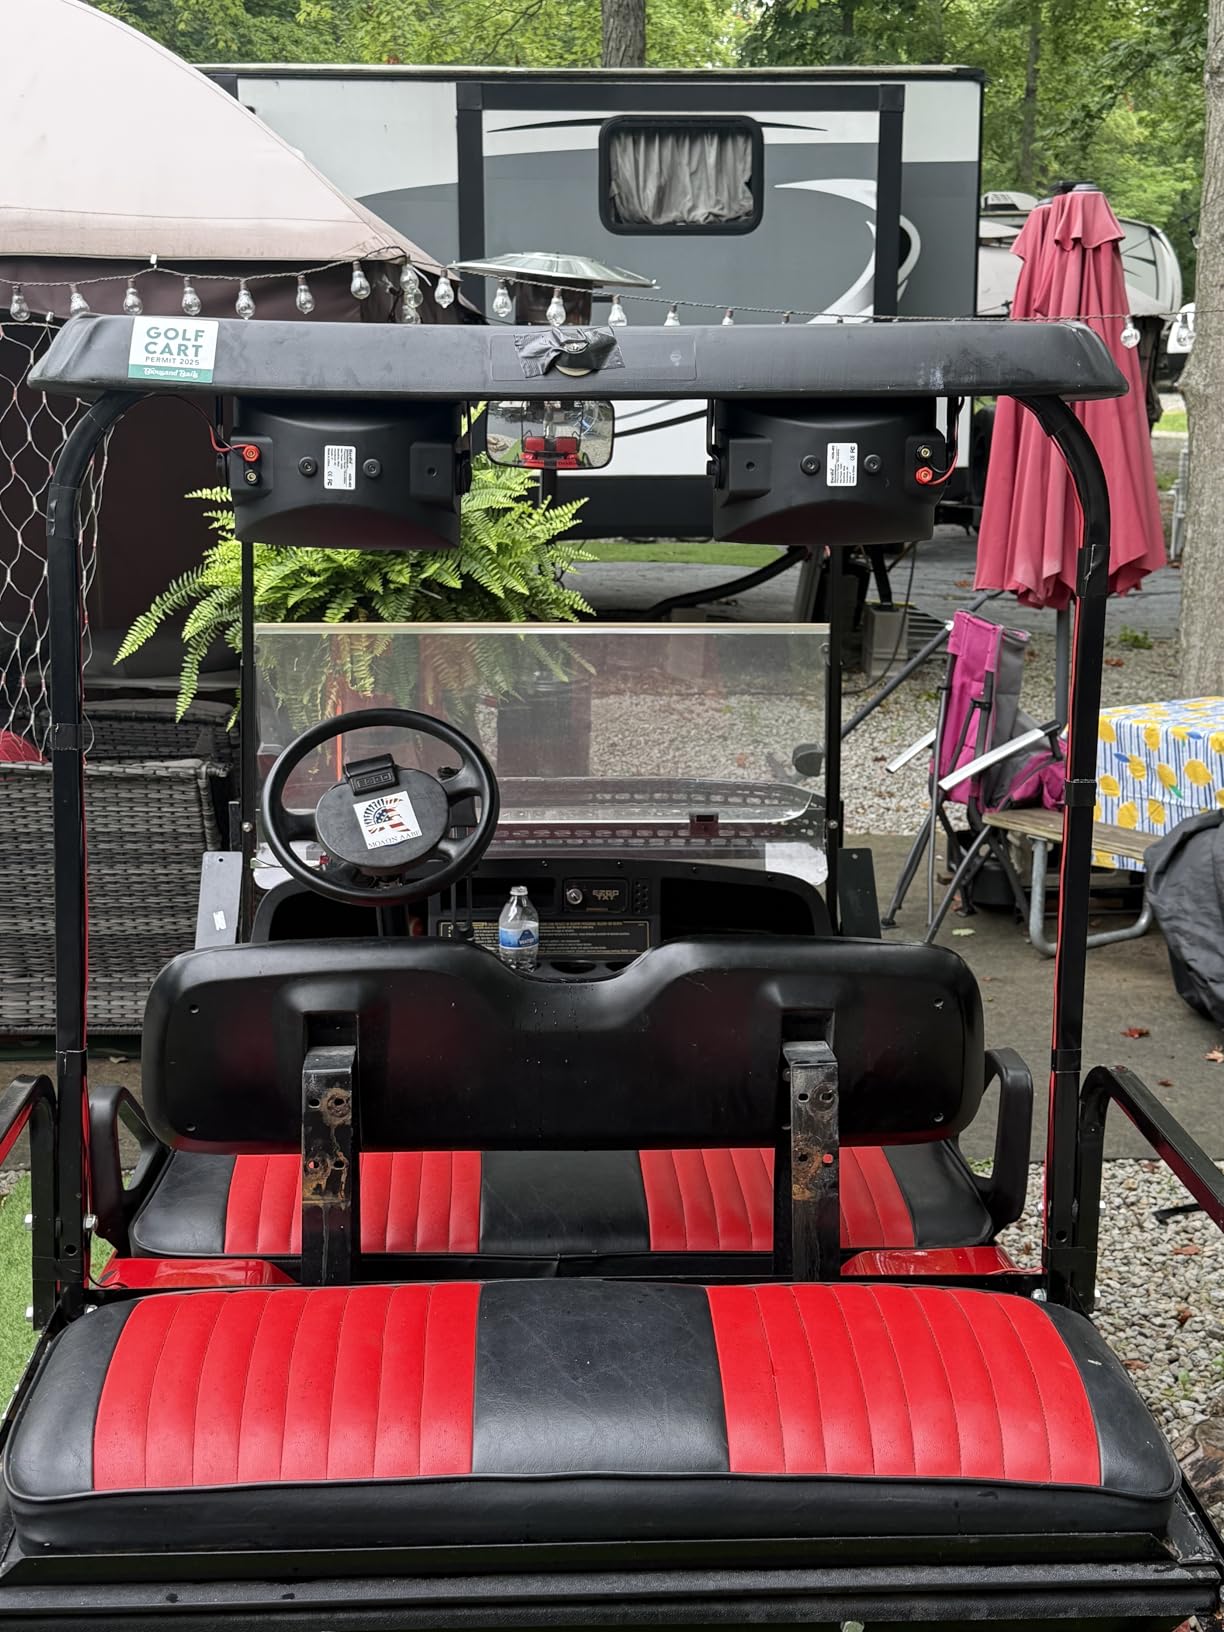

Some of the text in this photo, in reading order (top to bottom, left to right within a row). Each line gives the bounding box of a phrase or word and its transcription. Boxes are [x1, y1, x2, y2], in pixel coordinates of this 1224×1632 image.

[146, 326, 205, 342] GOLF
[144, 341, 203, 358] CART
[145, 356, 200, 366] PERMIT 2025
